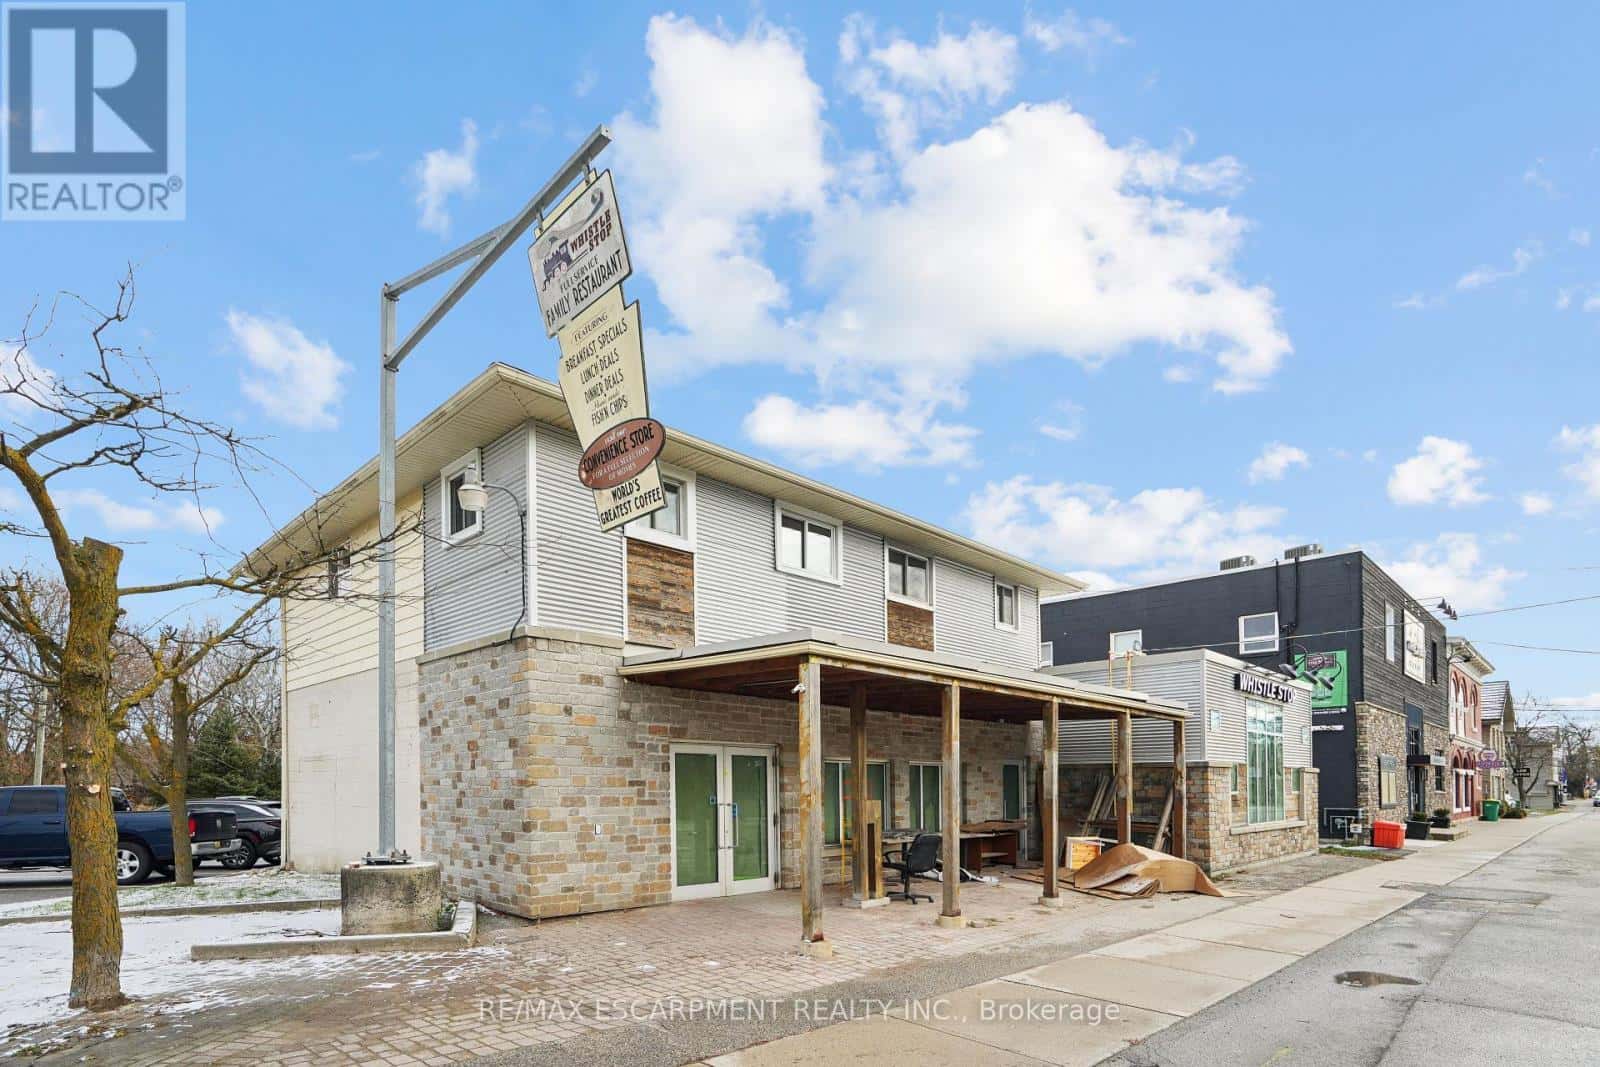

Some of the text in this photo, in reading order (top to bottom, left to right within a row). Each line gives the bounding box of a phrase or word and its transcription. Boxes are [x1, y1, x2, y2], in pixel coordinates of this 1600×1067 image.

[569, 209, 611, 254] WHISTLE
[588, 223, 612, 252] STOP
[573, 254, 599, 281] SERVICE
[546, 249, 622, 328] FAMILY RESTAURANT
[565, 317, 628, 373] BREAKFAST SPECIALS
[574, 311, 608, 342] FEATURING
[580, 347, 620, 385] LUNCH DEALS
[584, 382, 604, 405] DINNER
[604, 368, 624, 391] DEALS
[610, 394, 628, 415] CHIPS
[583, 437, 629, 473] CONVENIENCE
[630, 422, 655, 449] STORE
[600, 487, 662, 525] GREATEST COFFEE
[611, 478, 641, 502] WORLD'S
[1240, 672, 1276, 699] WHISTLE
